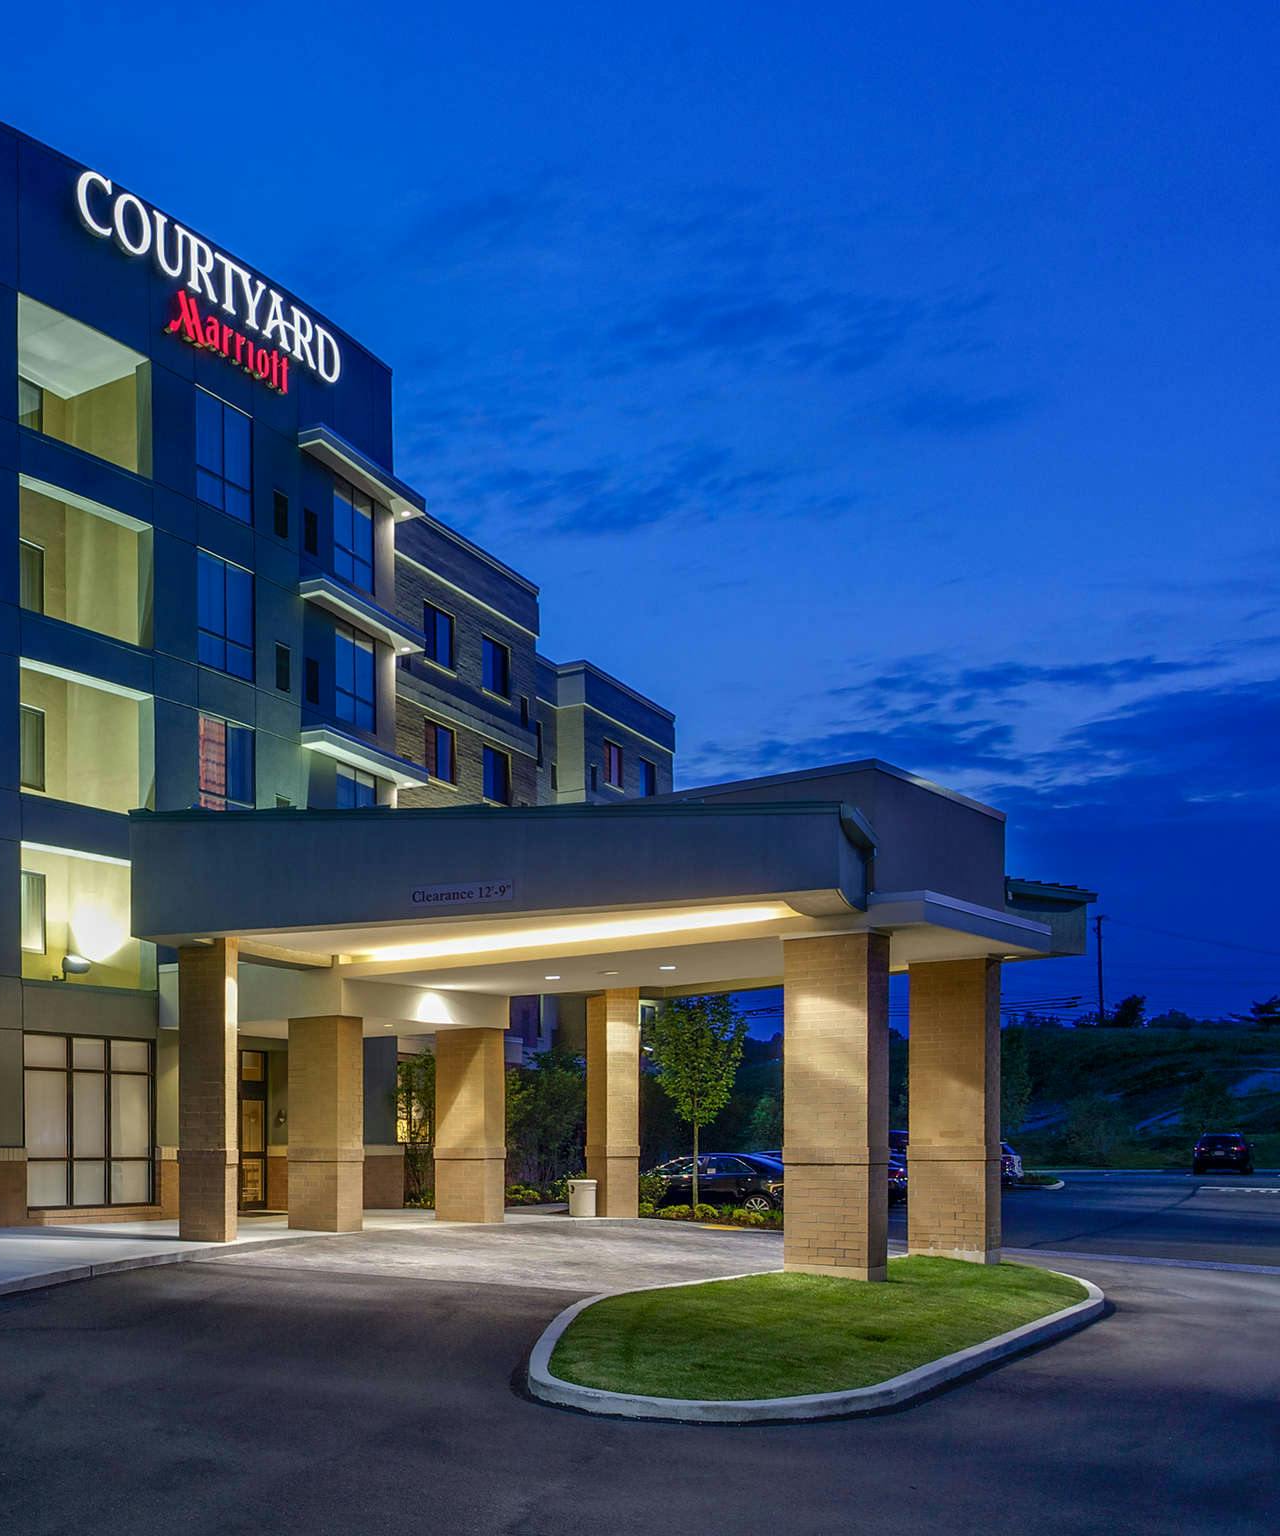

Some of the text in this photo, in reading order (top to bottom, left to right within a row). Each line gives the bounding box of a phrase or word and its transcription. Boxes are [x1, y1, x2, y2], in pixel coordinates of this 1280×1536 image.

[76, 170, 342, 384] COURTYARD
[166, 289, 290, 395] Marriott
[412, 889, 475, 903] Clearance
